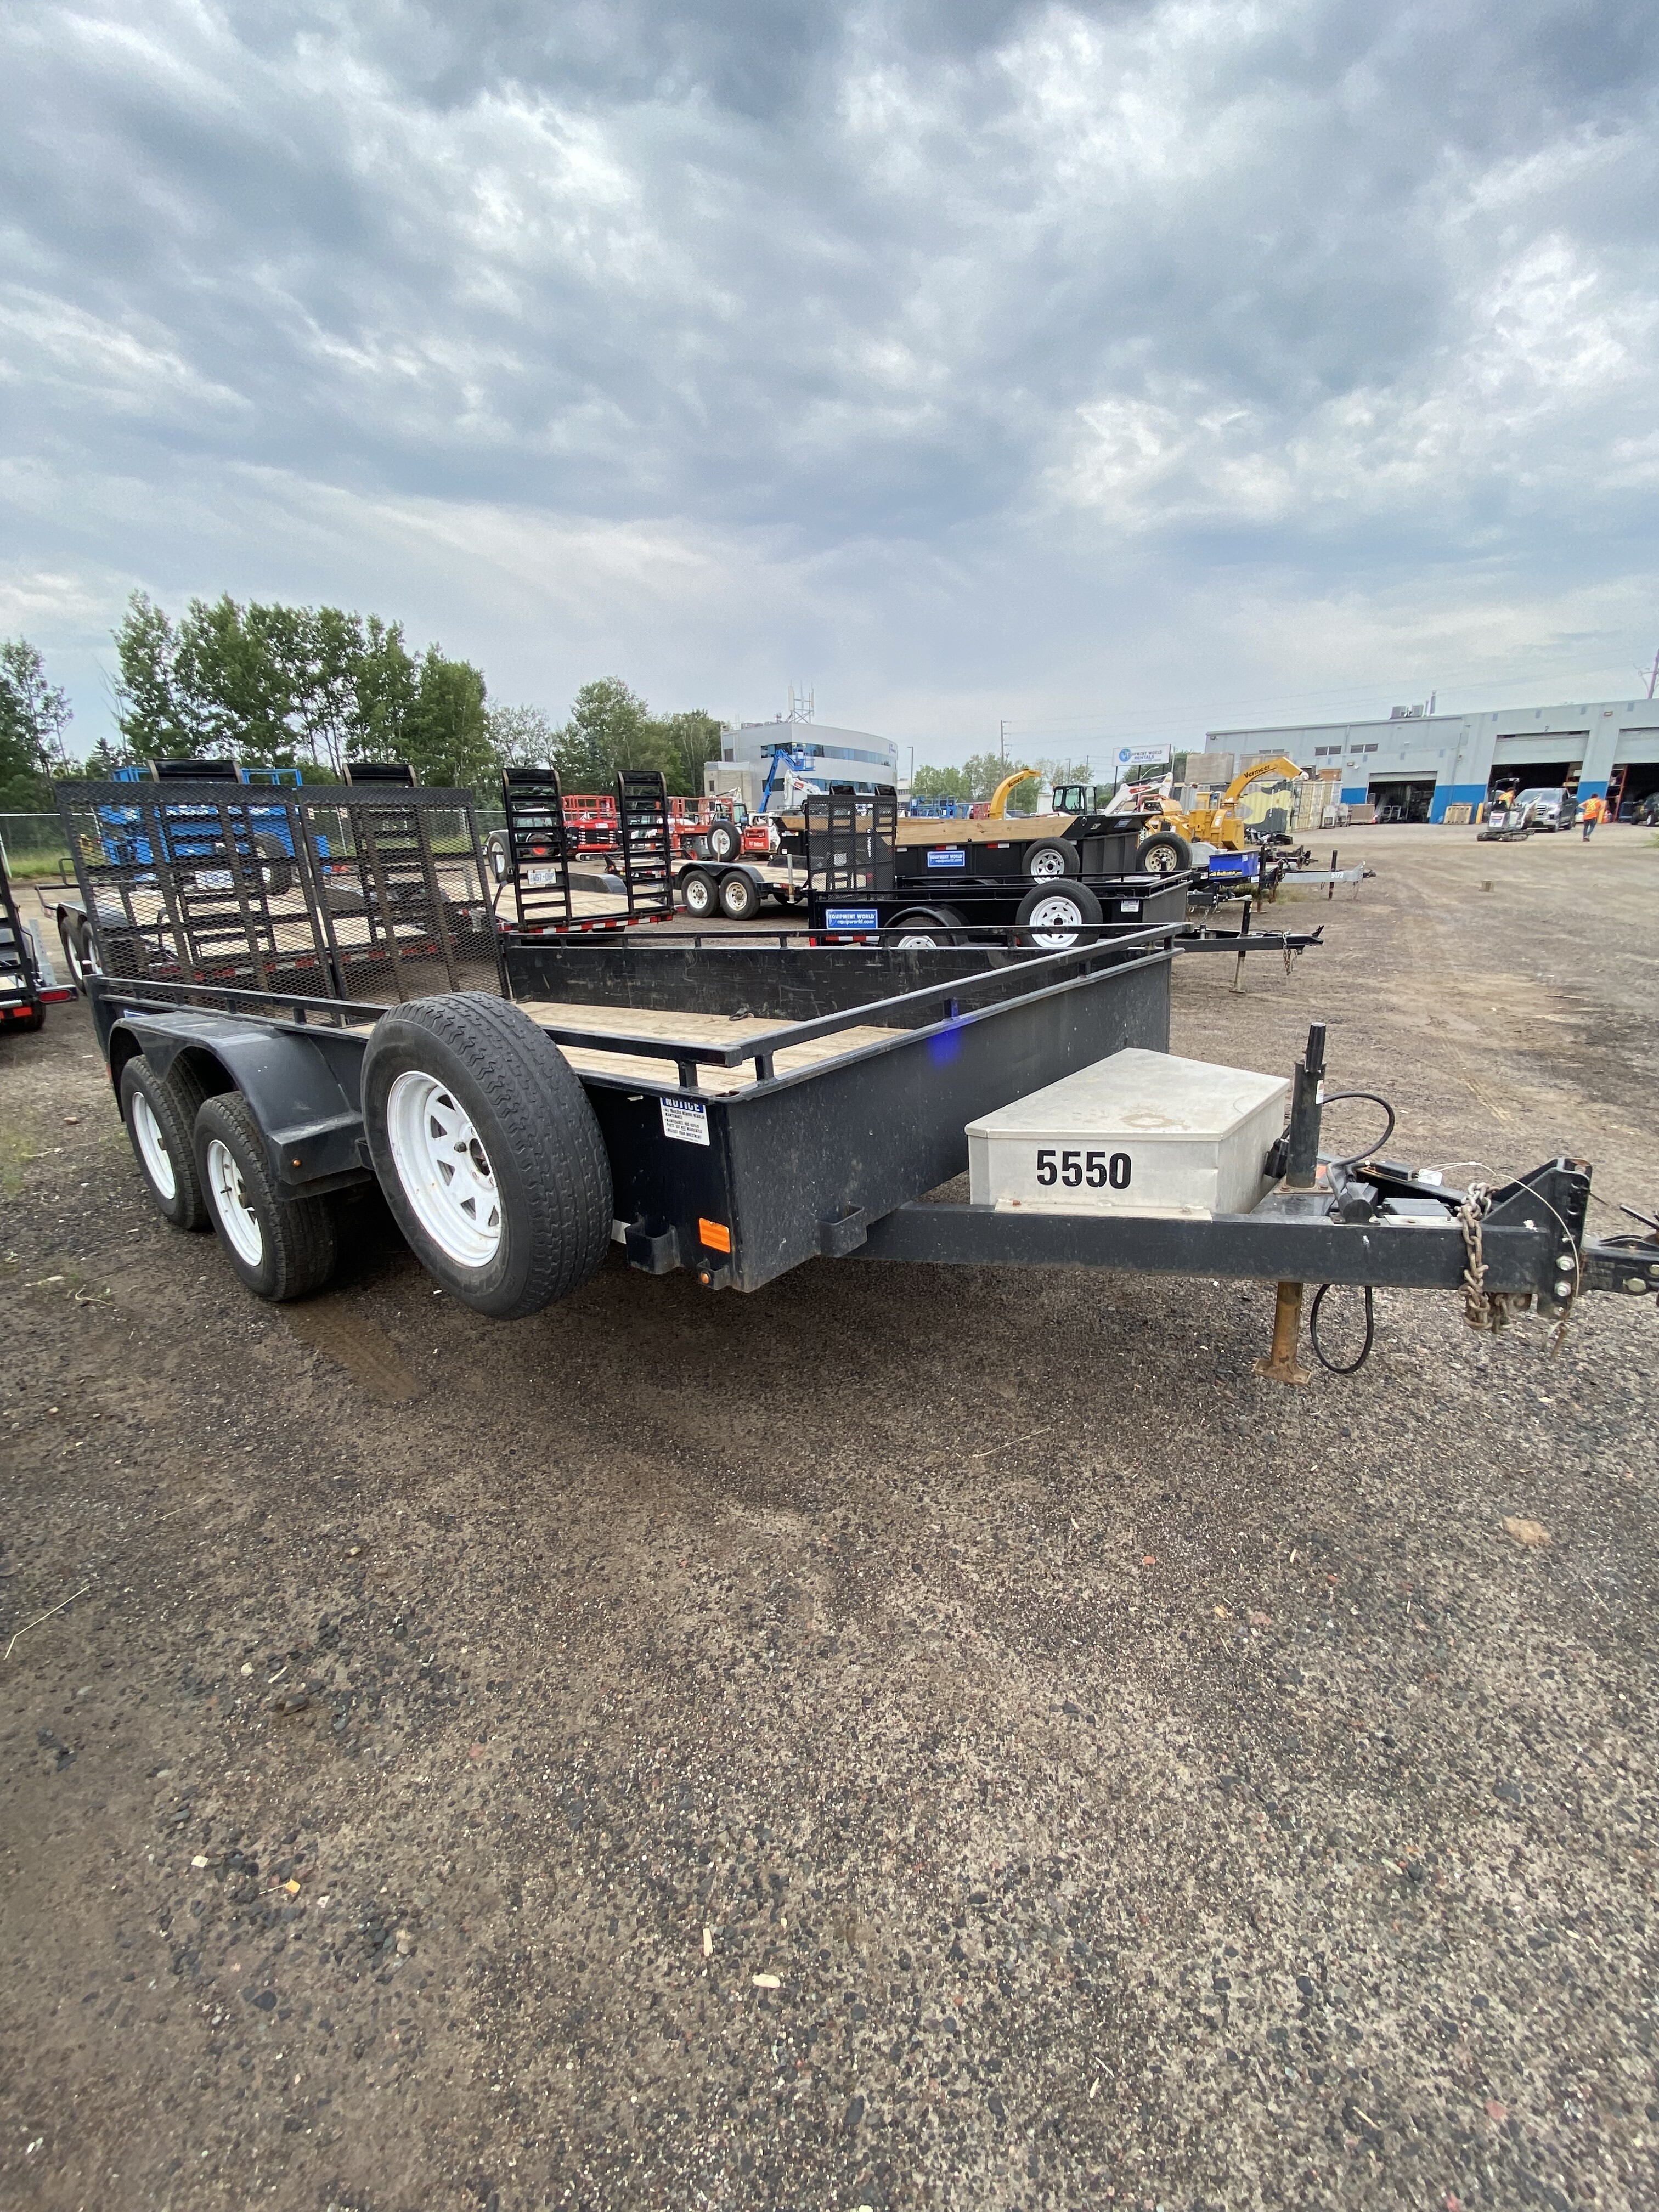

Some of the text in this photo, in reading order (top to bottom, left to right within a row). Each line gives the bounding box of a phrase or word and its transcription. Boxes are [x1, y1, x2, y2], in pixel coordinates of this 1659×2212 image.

[1244, 765, 1271, 778] Vermeer
[665, 1098, 701, 1111] NOTICE
[1036, 1150, 1132, 1189] 5550
